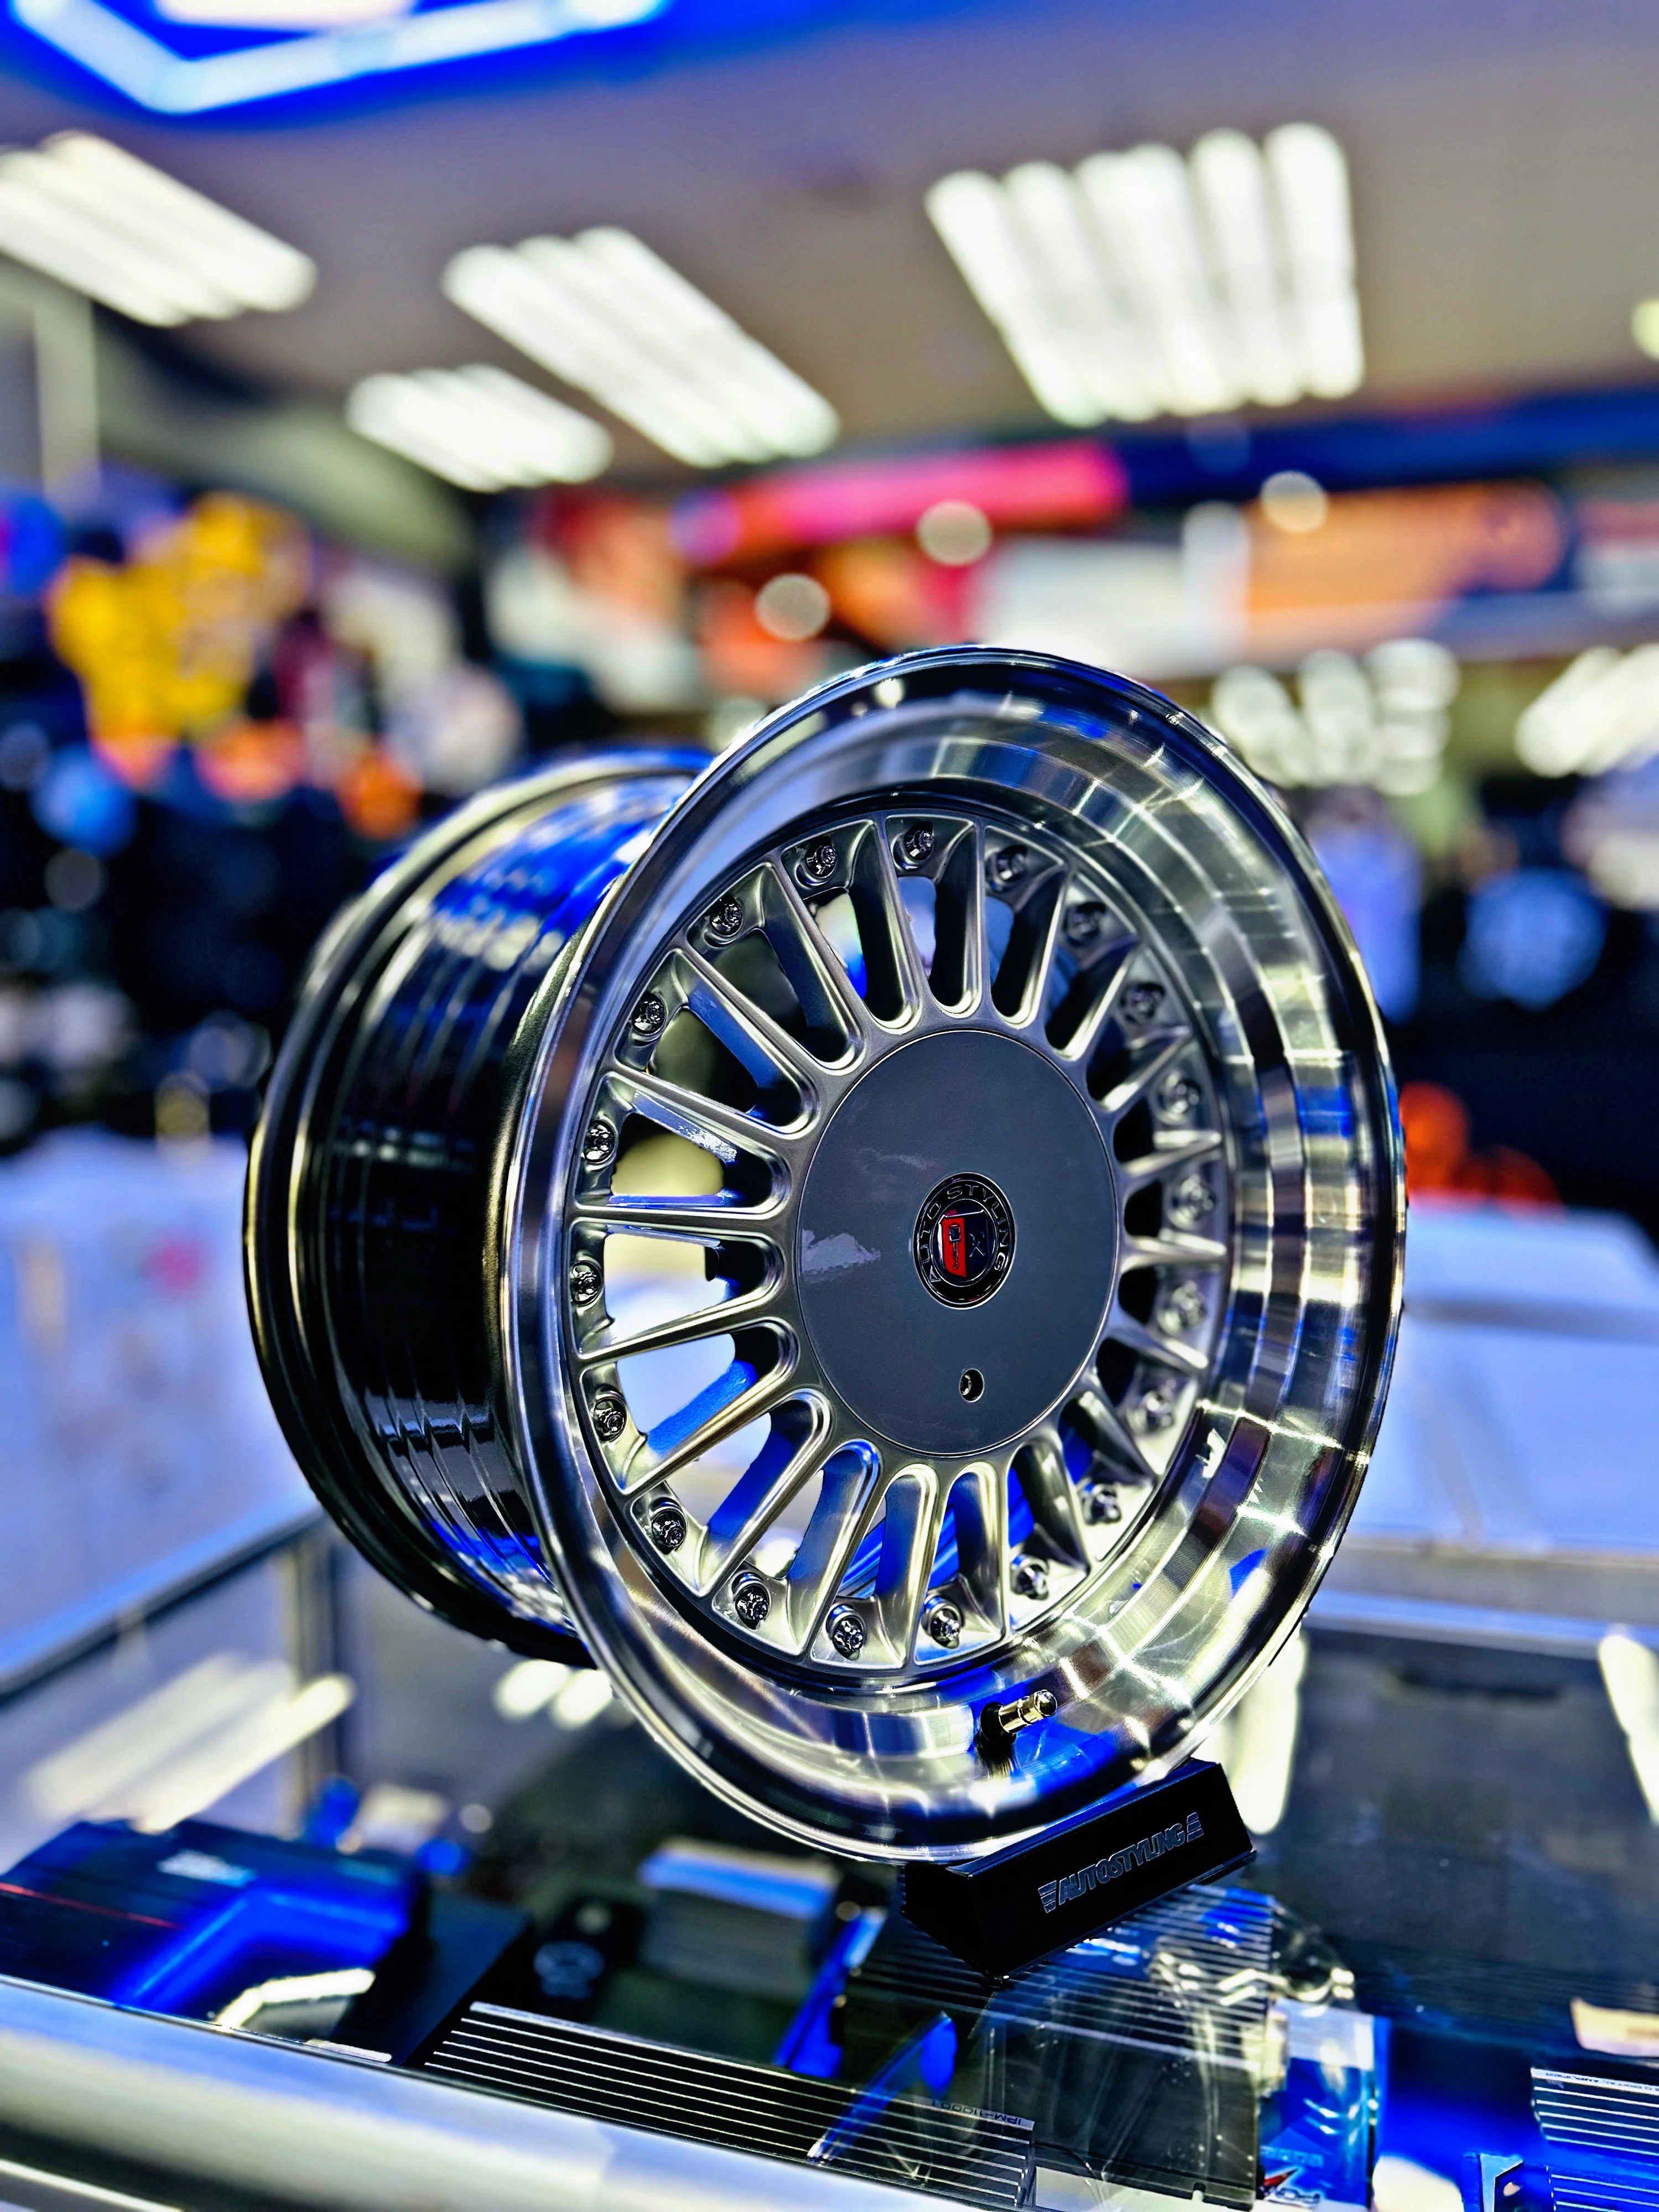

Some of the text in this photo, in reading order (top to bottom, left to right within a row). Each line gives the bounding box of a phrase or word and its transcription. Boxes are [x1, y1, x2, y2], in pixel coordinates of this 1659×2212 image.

[920, 1183, 1008, 1283] AUTO STYLING
[1058, 1823, 1185, 1906] AUTOSTYLING
